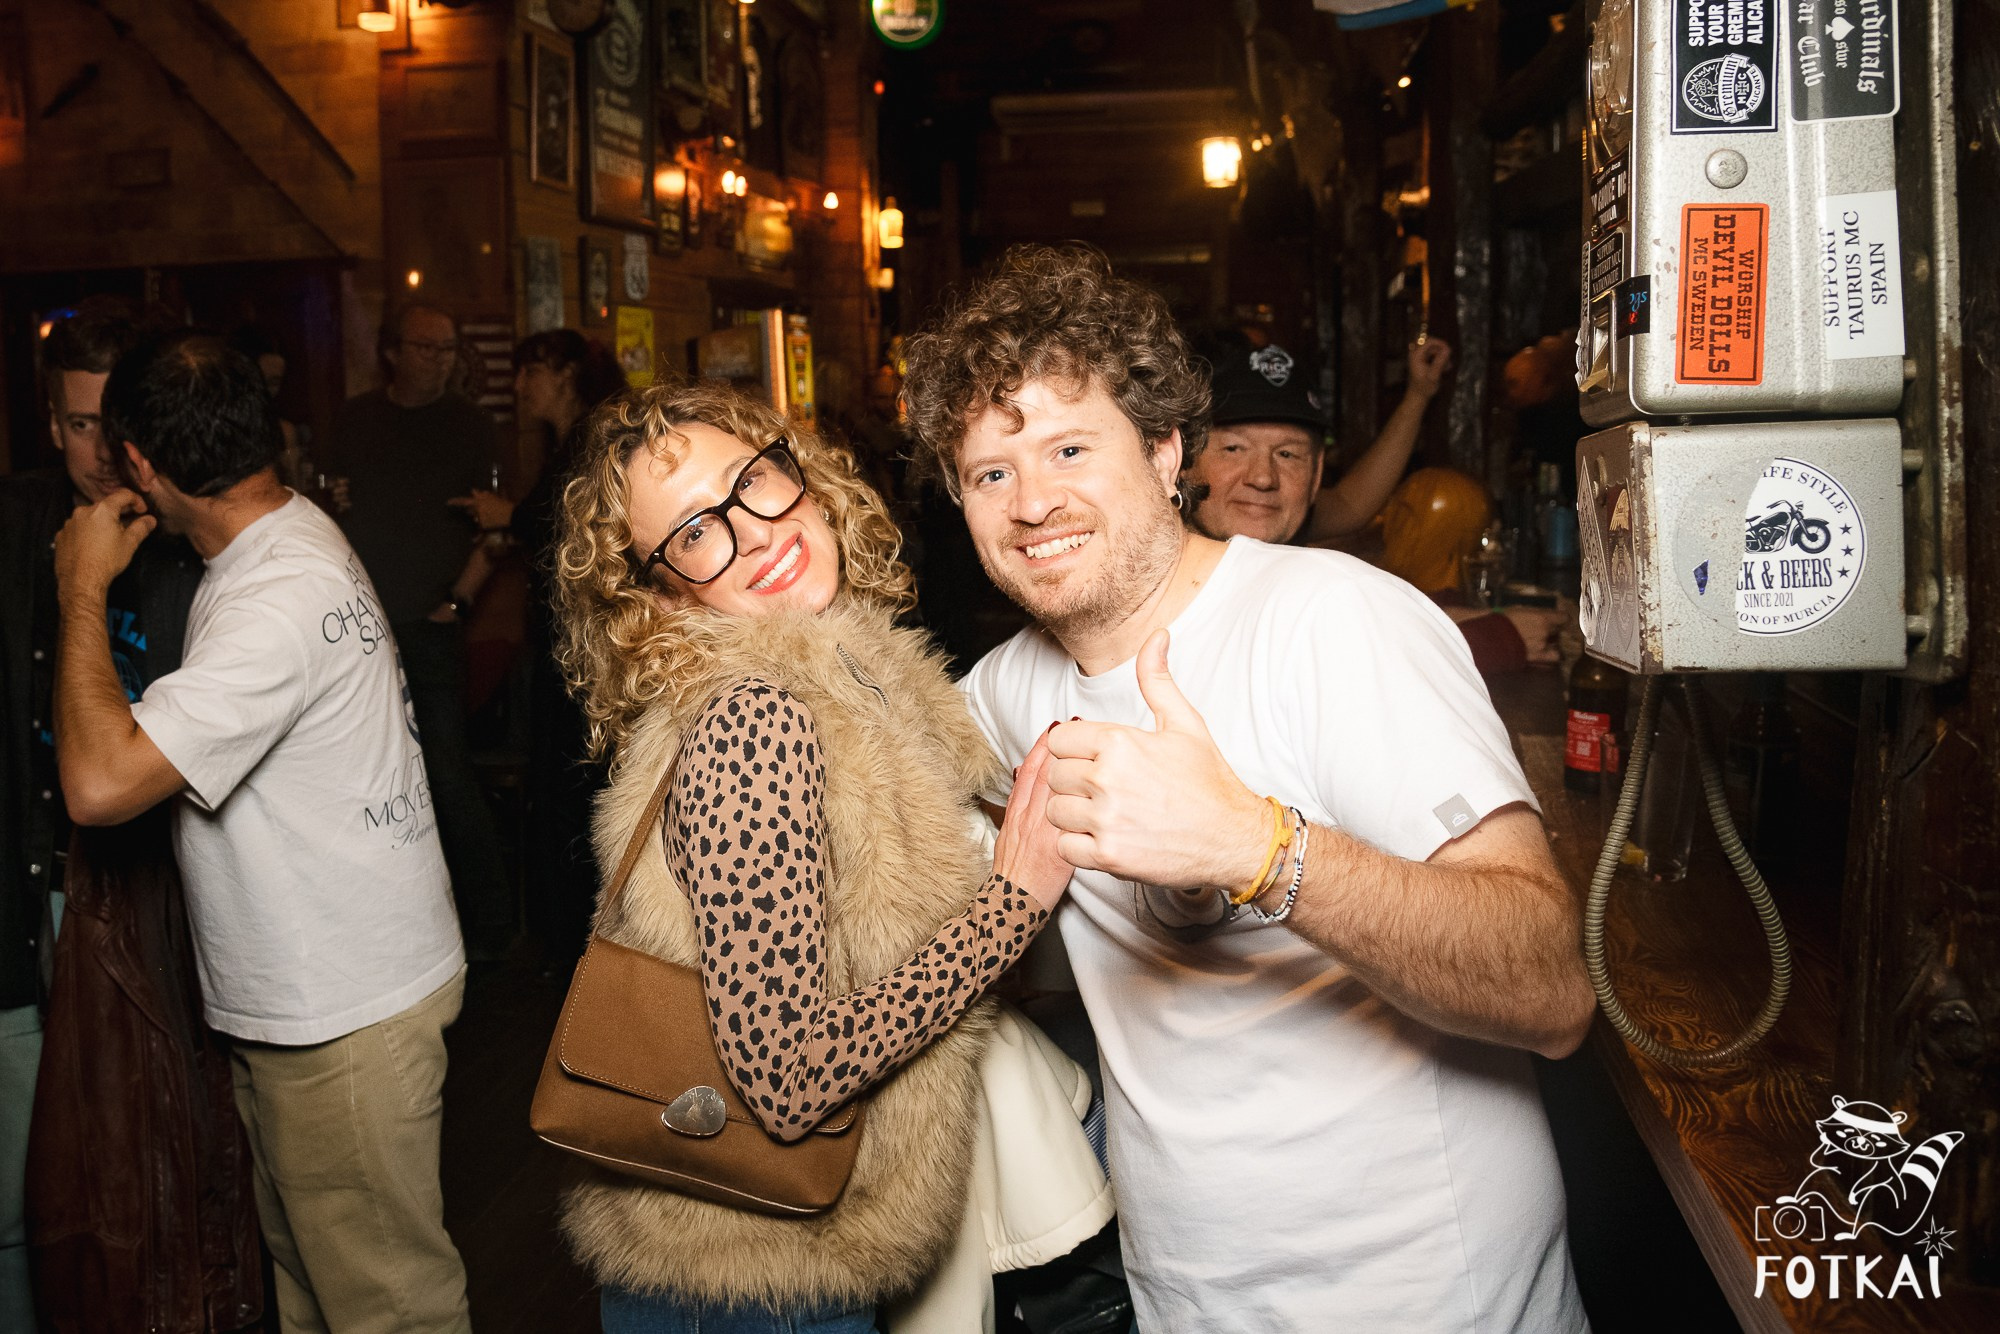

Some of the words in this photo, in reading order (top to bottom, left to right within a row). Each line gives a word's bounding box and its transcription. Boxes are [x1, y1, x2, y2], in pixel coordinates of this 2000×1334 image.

[1707, 4, 1724, 47] YOUR
[1727, 0, 1744, 45] GREM
[1797, 35, 1826, 87] Club
[1835, 41, 1850, 68] swe
[1721, 60, 1738, 117] Gremium
[1749, 68, 1761, 108] ALICANTE
[1842, 210, 1860, 246] MC
[1693, 237, 1709, 265] MC
[1711, 214, 1736, 288] DEVIL
[1869, 242, 1888, 305] SPAIN
[1736, 249, 1755, 340] WORSHIP
[1819, 227, 1840, 327] SUPPORT
[1845, 253, 1864, 339] TAURUS
[1689, 270, 1707, 351] SWEDEN
[1707, 295, 1733, 373] DOLLS
[1797, 471, 1848, 514] STYLE
[1761, 560, 1774, 590] &
[1779, 558, 1833, 589] BEERS
[1743, 592, 1772, 609] SINCE
[1774, 592, 1795, 607] 2021
[1762, 615, 1781, 625] OF
[1783, 594, 1836, 624] MURCIA
